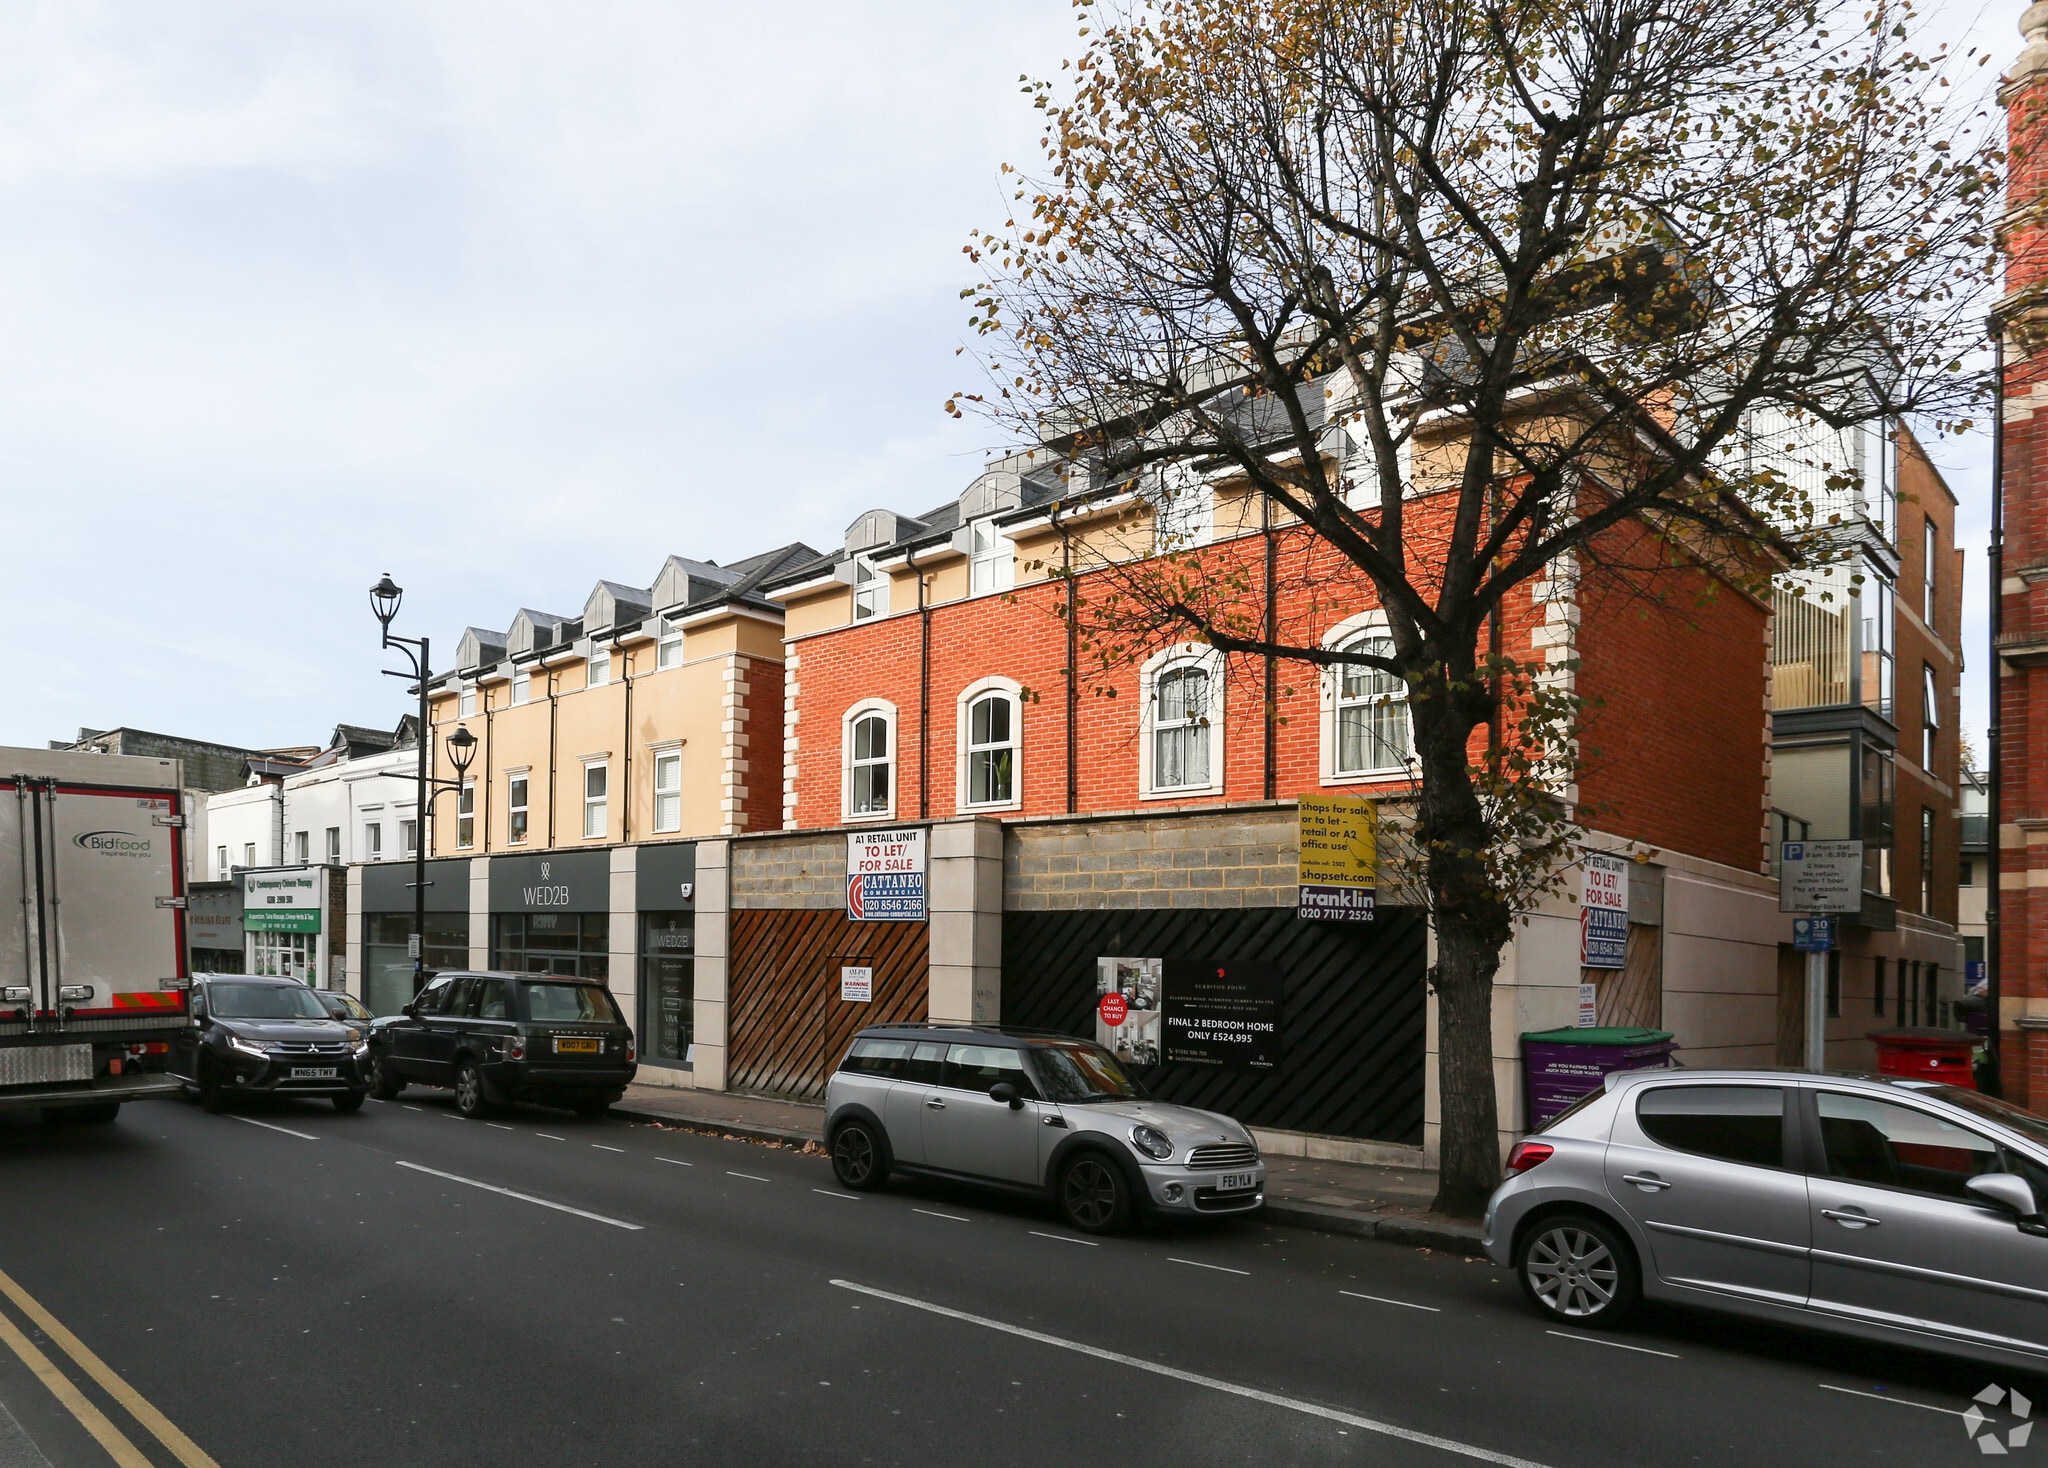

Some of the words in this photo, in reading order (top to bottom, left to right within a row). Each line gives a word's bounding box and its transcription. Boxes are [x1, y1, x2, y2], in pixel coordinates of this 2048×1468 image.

[1302, 802, 1330, 813] shops
[1333, 804, 1347, 814] for
[1350, 806, 1369, 816] sale
[1315, 817, 1325, 825] to
[1328, 816, 1340, 825] let
[855, 835, 864, 844] A1
[867, 833, 894, 843] RETAIL
[896, 832, 917, 842] UNIT
[1302, 828, 1327, 837] retail
[1344, 830, 1357, 839] A2
[91, 837, 151, 851] Bidfood
[865, 846, 880, 857] TO
[884, 844, 907, 857] LET/
[1302, 840, 1328, 849] office
[1788, 845, 1800, 859] P
[859, 860, 881, 871] FOR
[885, 859, 913, 871] SALE
[1592, 857, 1611, 870] RETAIL
[1611, 861, 1624, 873] UNIT
[864, 874, 922, 889] CATTANEO
[1301, 869, 1374, 883] shopsetc.com
[1590, 871, 1601, 886] TO
[282, 879, 296, 887] Chinese
[297, 878, 312, 889] Therapy
[523, 886, 569, 906] WED2B
[1301, 887, 1375, 908] franklin
[1586, 888, 1602, 904] FOR
[1604, 891, 1622, 907] SALE
[864, 900, 879, 911] 020
[881, 900, 901, 911] 8546
[903, 899, 922, 910] 2166
[1301, 908, 1320, 918] 020
[1323, 909, 1346, 920] 7117
[1348, 910, 1374, 921] 2526
[1589, 910, 1626, 929] CATTANEO
[1813, 920, 1828, 930] 30
[657, 935, 689, 948] WED2B
[1168, 1018, 1192, 1027] FINAL
[1194, 1019, 1200, 1028] 2
[1201, 1020, 1245, 1030] BEDROOM
[1247, 1022, 1274, 1032] HOME
[1187, 1031, 1210, 1040] ONLY
[1213, 1032, 1253, 1043] £524,995
